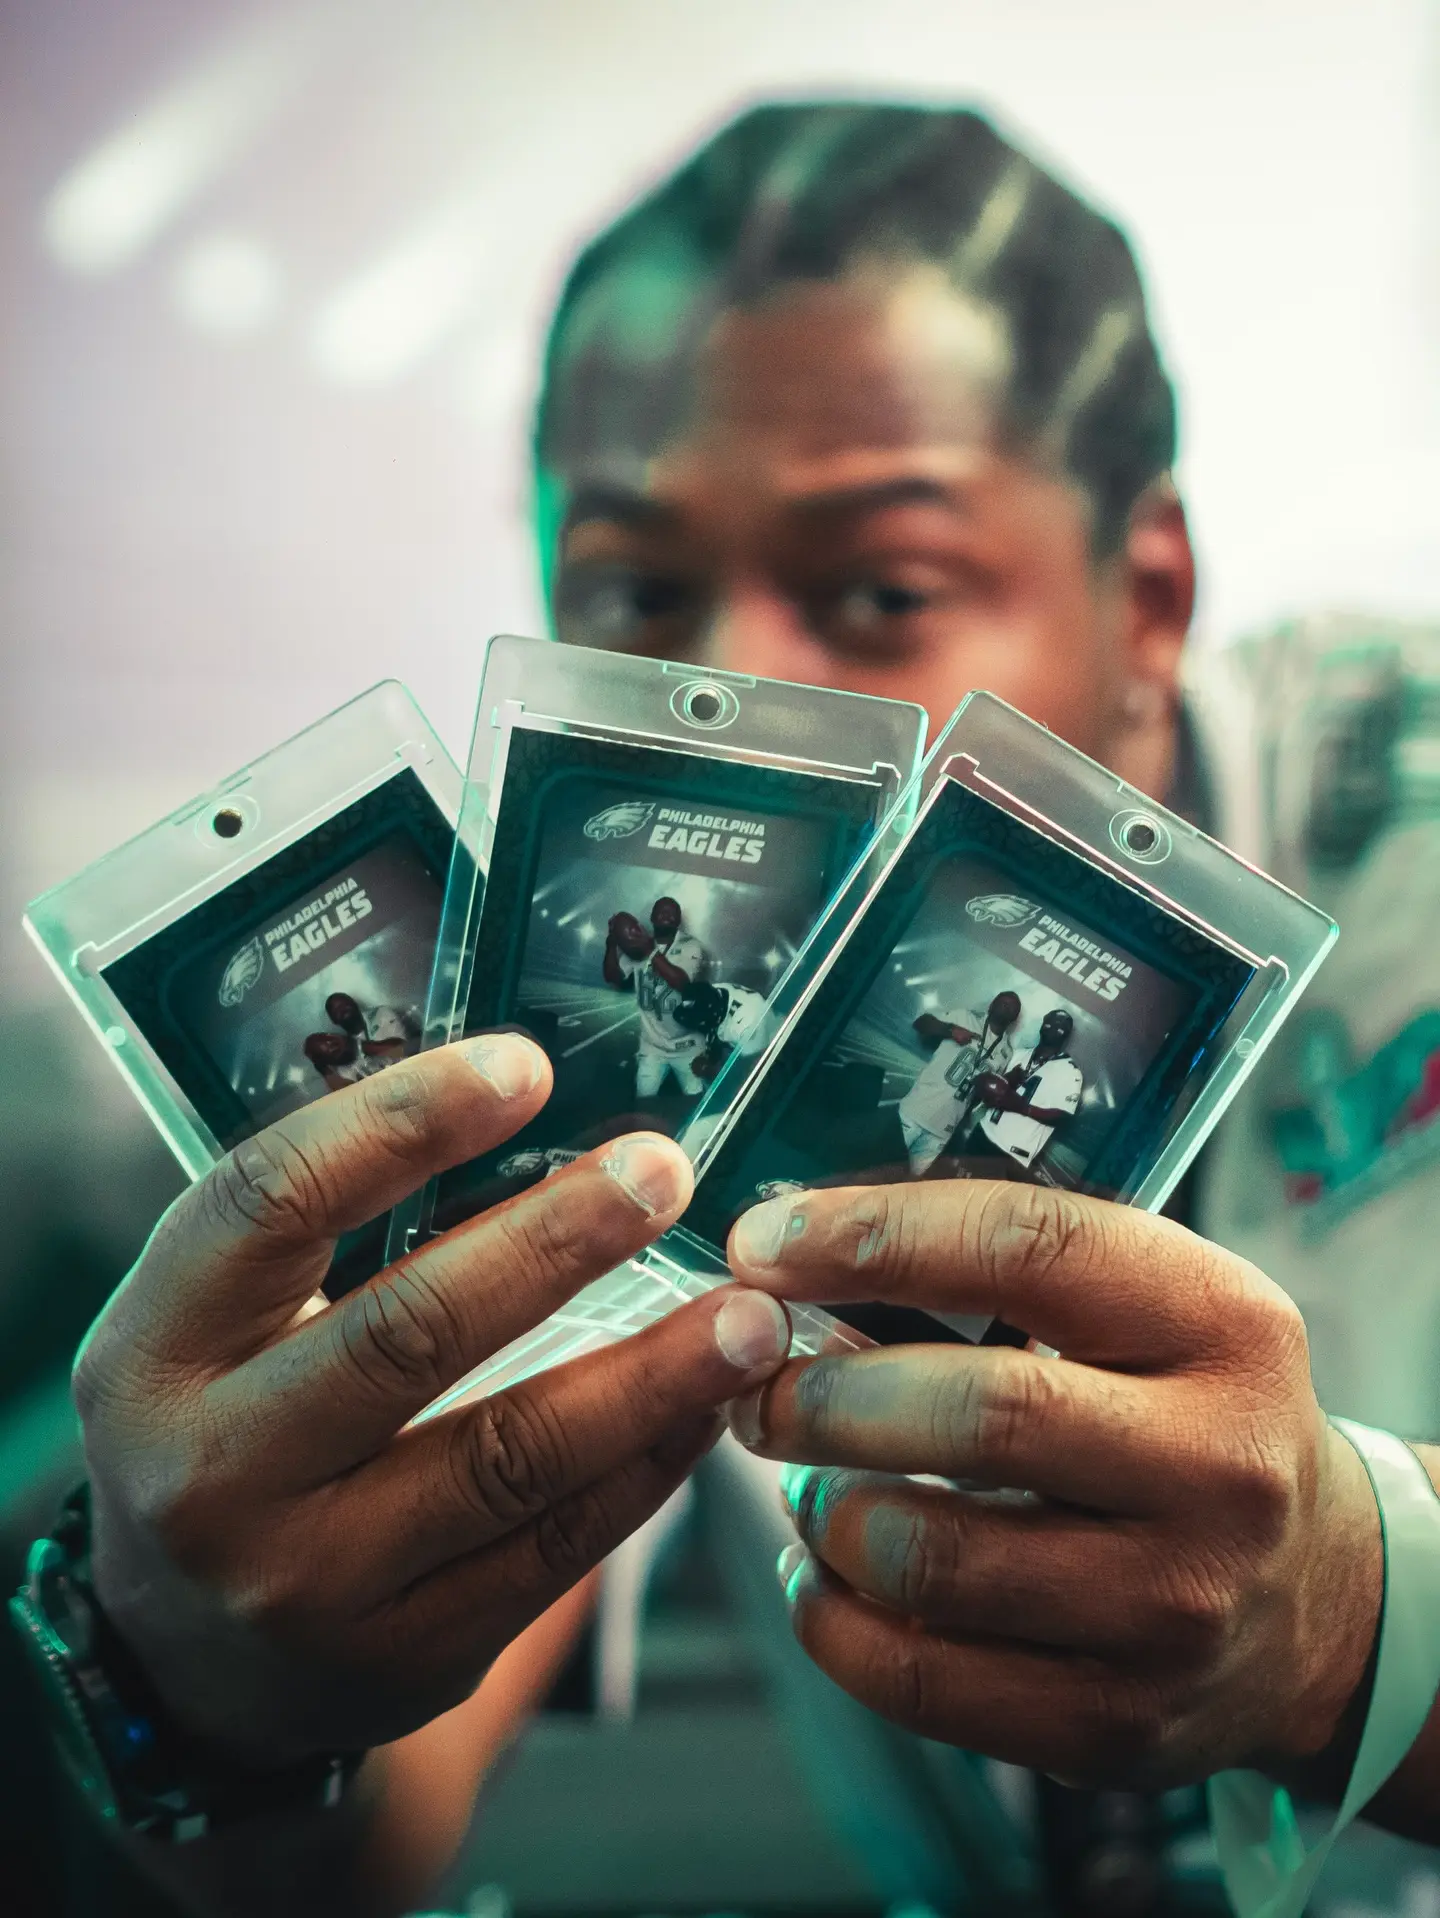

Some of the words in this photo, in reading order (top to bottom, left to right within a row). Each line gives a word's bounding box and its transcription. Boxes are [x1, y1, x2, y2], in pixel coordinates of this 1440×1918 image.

[648, 824, 766, 864] EAGLES
[657, 808, 765, 837] PHILADELPHIA
[264, 877, 358, 946] PHILADELPHIA
[272, 889, 373, 973] EAGLES
[1018, 927, 1127, 1002] EAGLES
[1038, 914, 1133, 979] PHILADELPHIA
